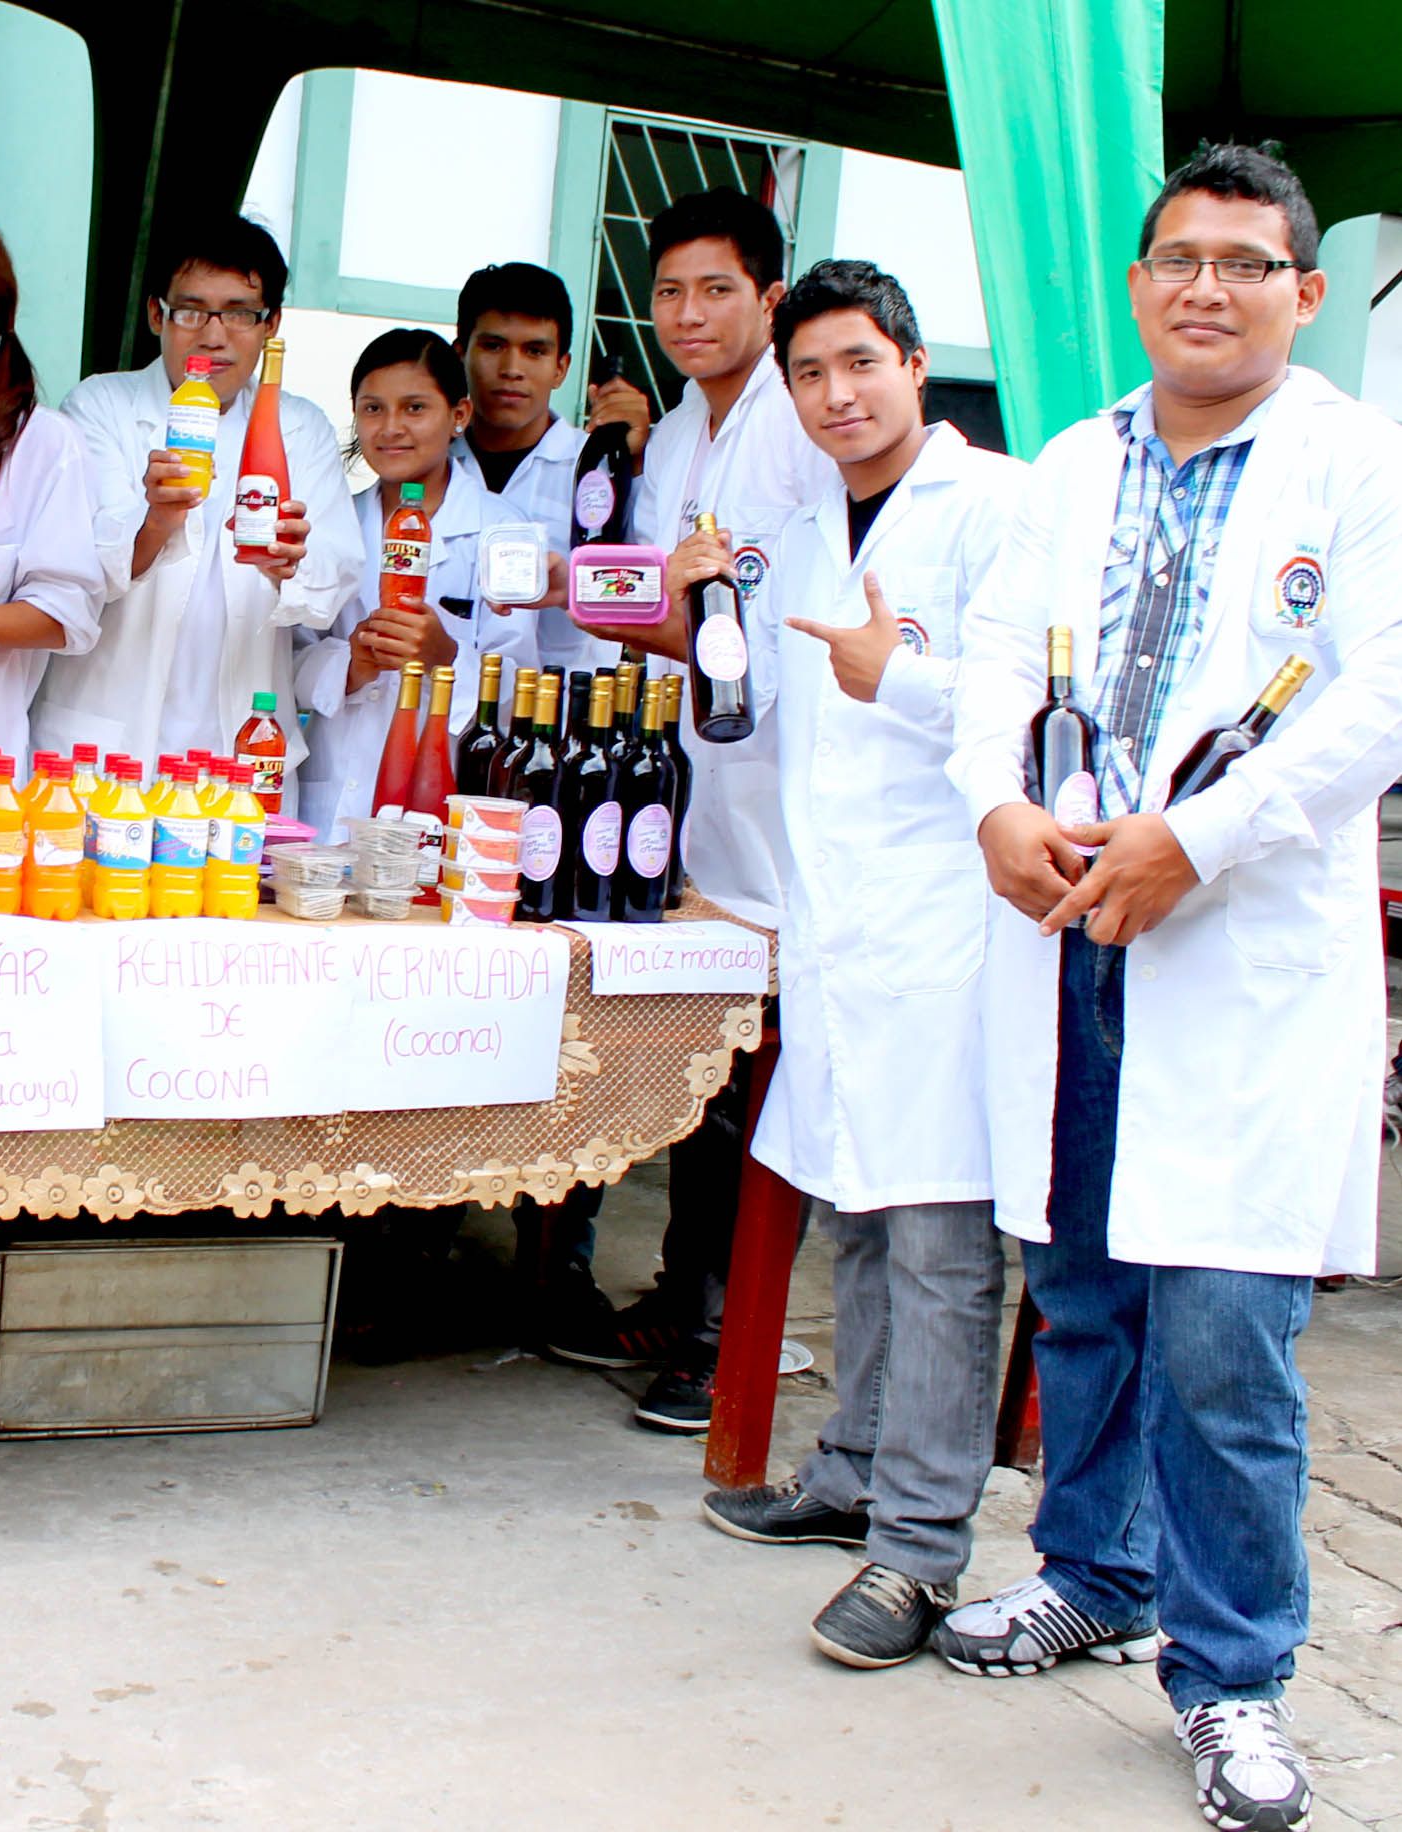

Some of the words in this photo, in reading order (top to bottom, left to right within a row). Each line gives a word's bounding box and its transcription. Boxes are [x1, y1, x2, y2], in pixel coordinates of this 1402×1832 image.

[117, 935, 339, 994] REHIDRATANTE
[680, 940, 766, 974] morado)
[200, 1002, 246, 1038] DE
[384, 1018, 502, 1066] (Cocona)
[126, 1058, 269, 1101] COCONA
